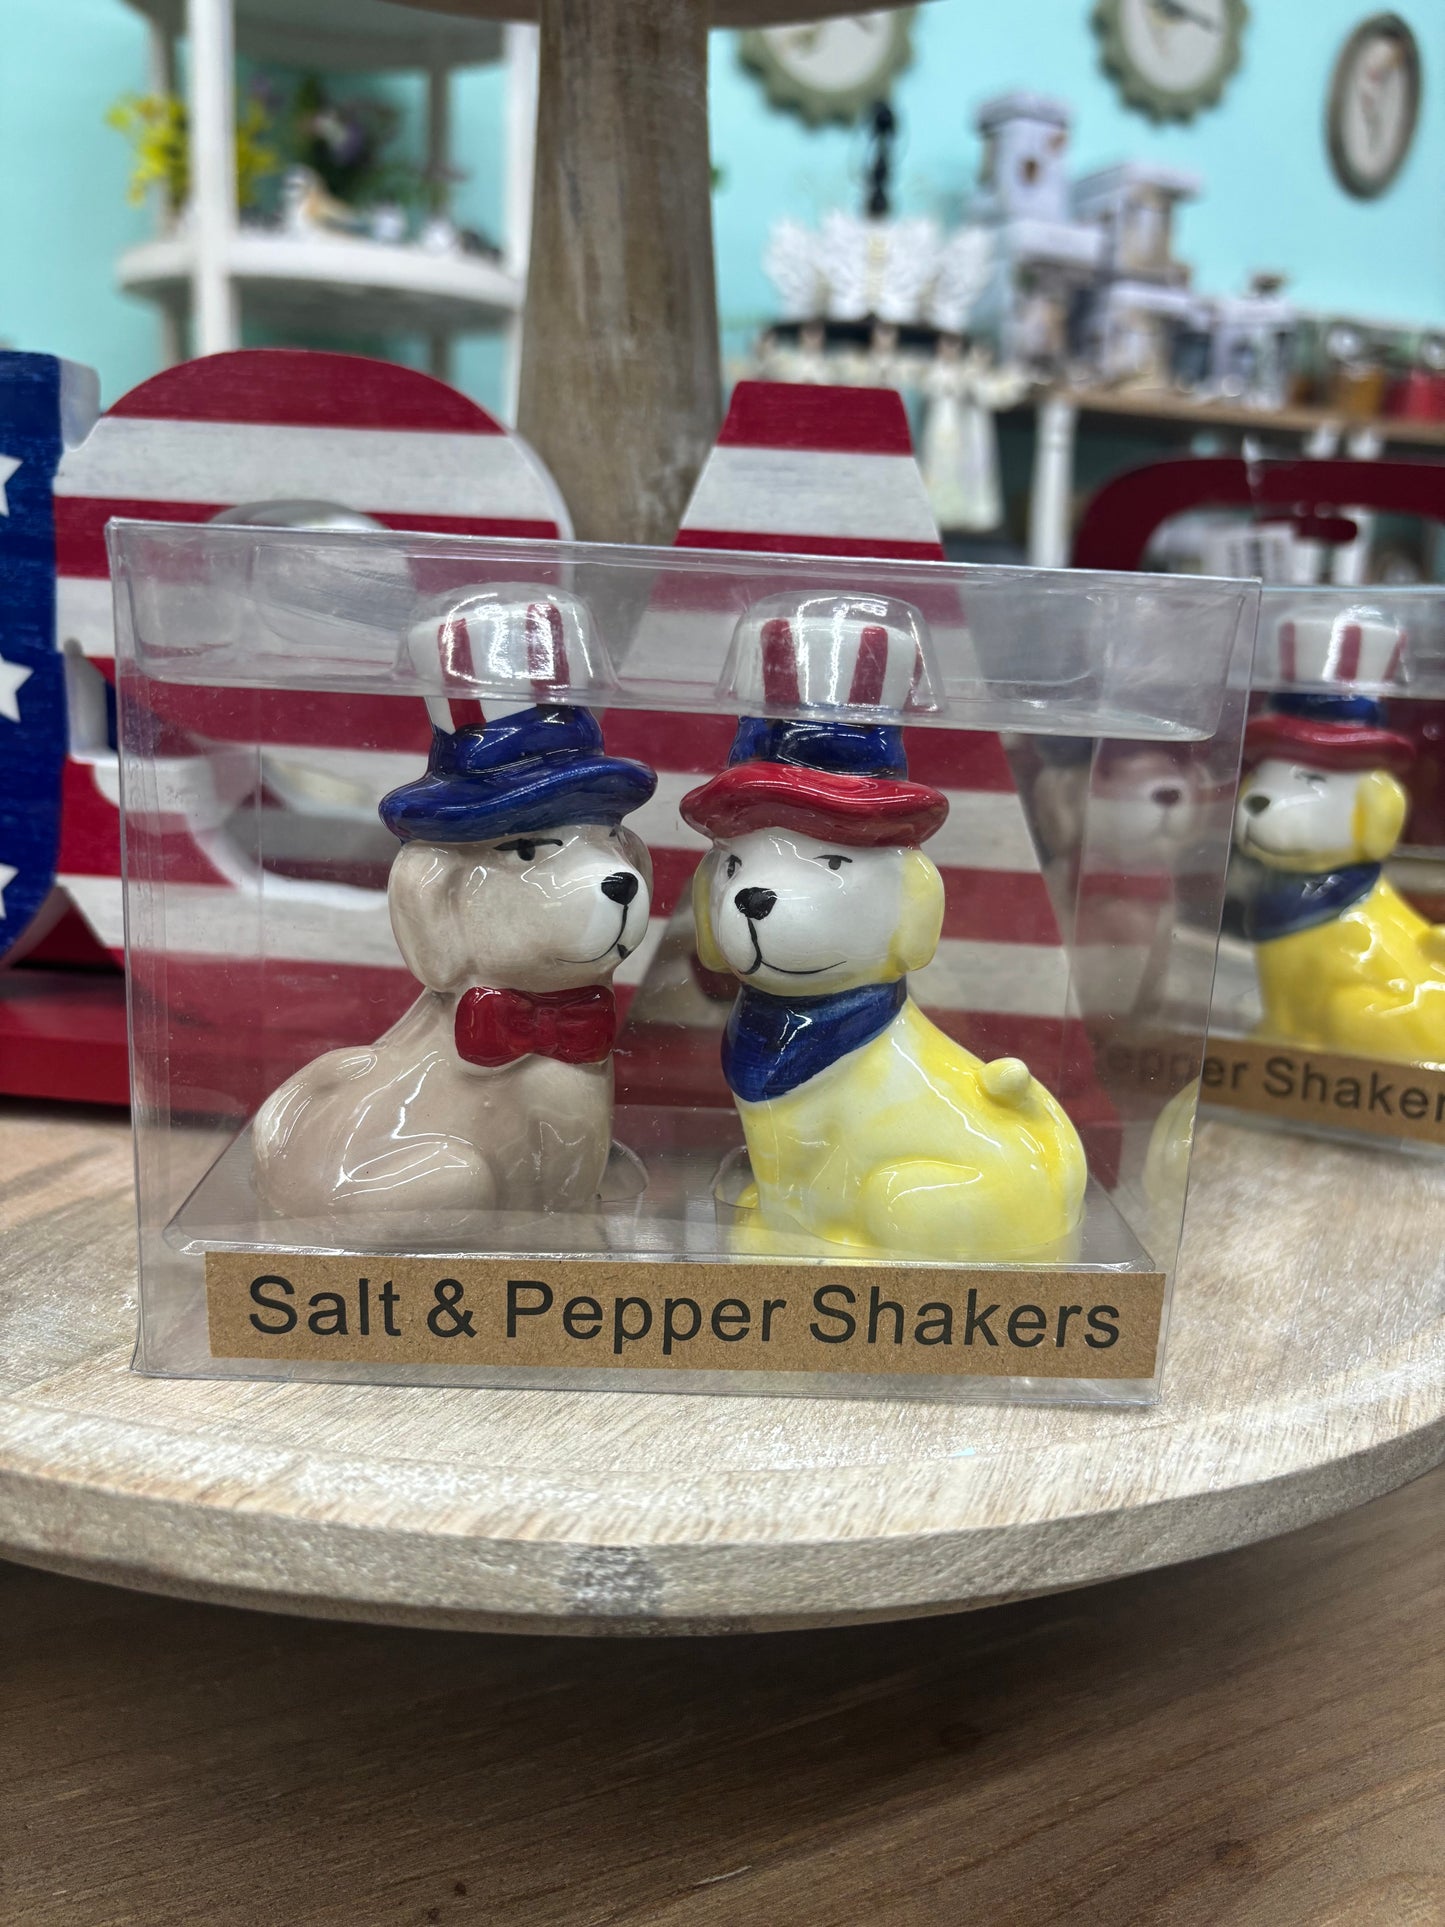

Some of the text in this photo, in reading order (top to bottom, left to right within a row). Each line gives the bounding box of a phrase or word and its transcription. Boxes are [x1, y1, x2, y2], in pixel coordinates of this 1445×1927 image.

[248, 1274, 1121, 1356] Salt & Pepper Shakers
